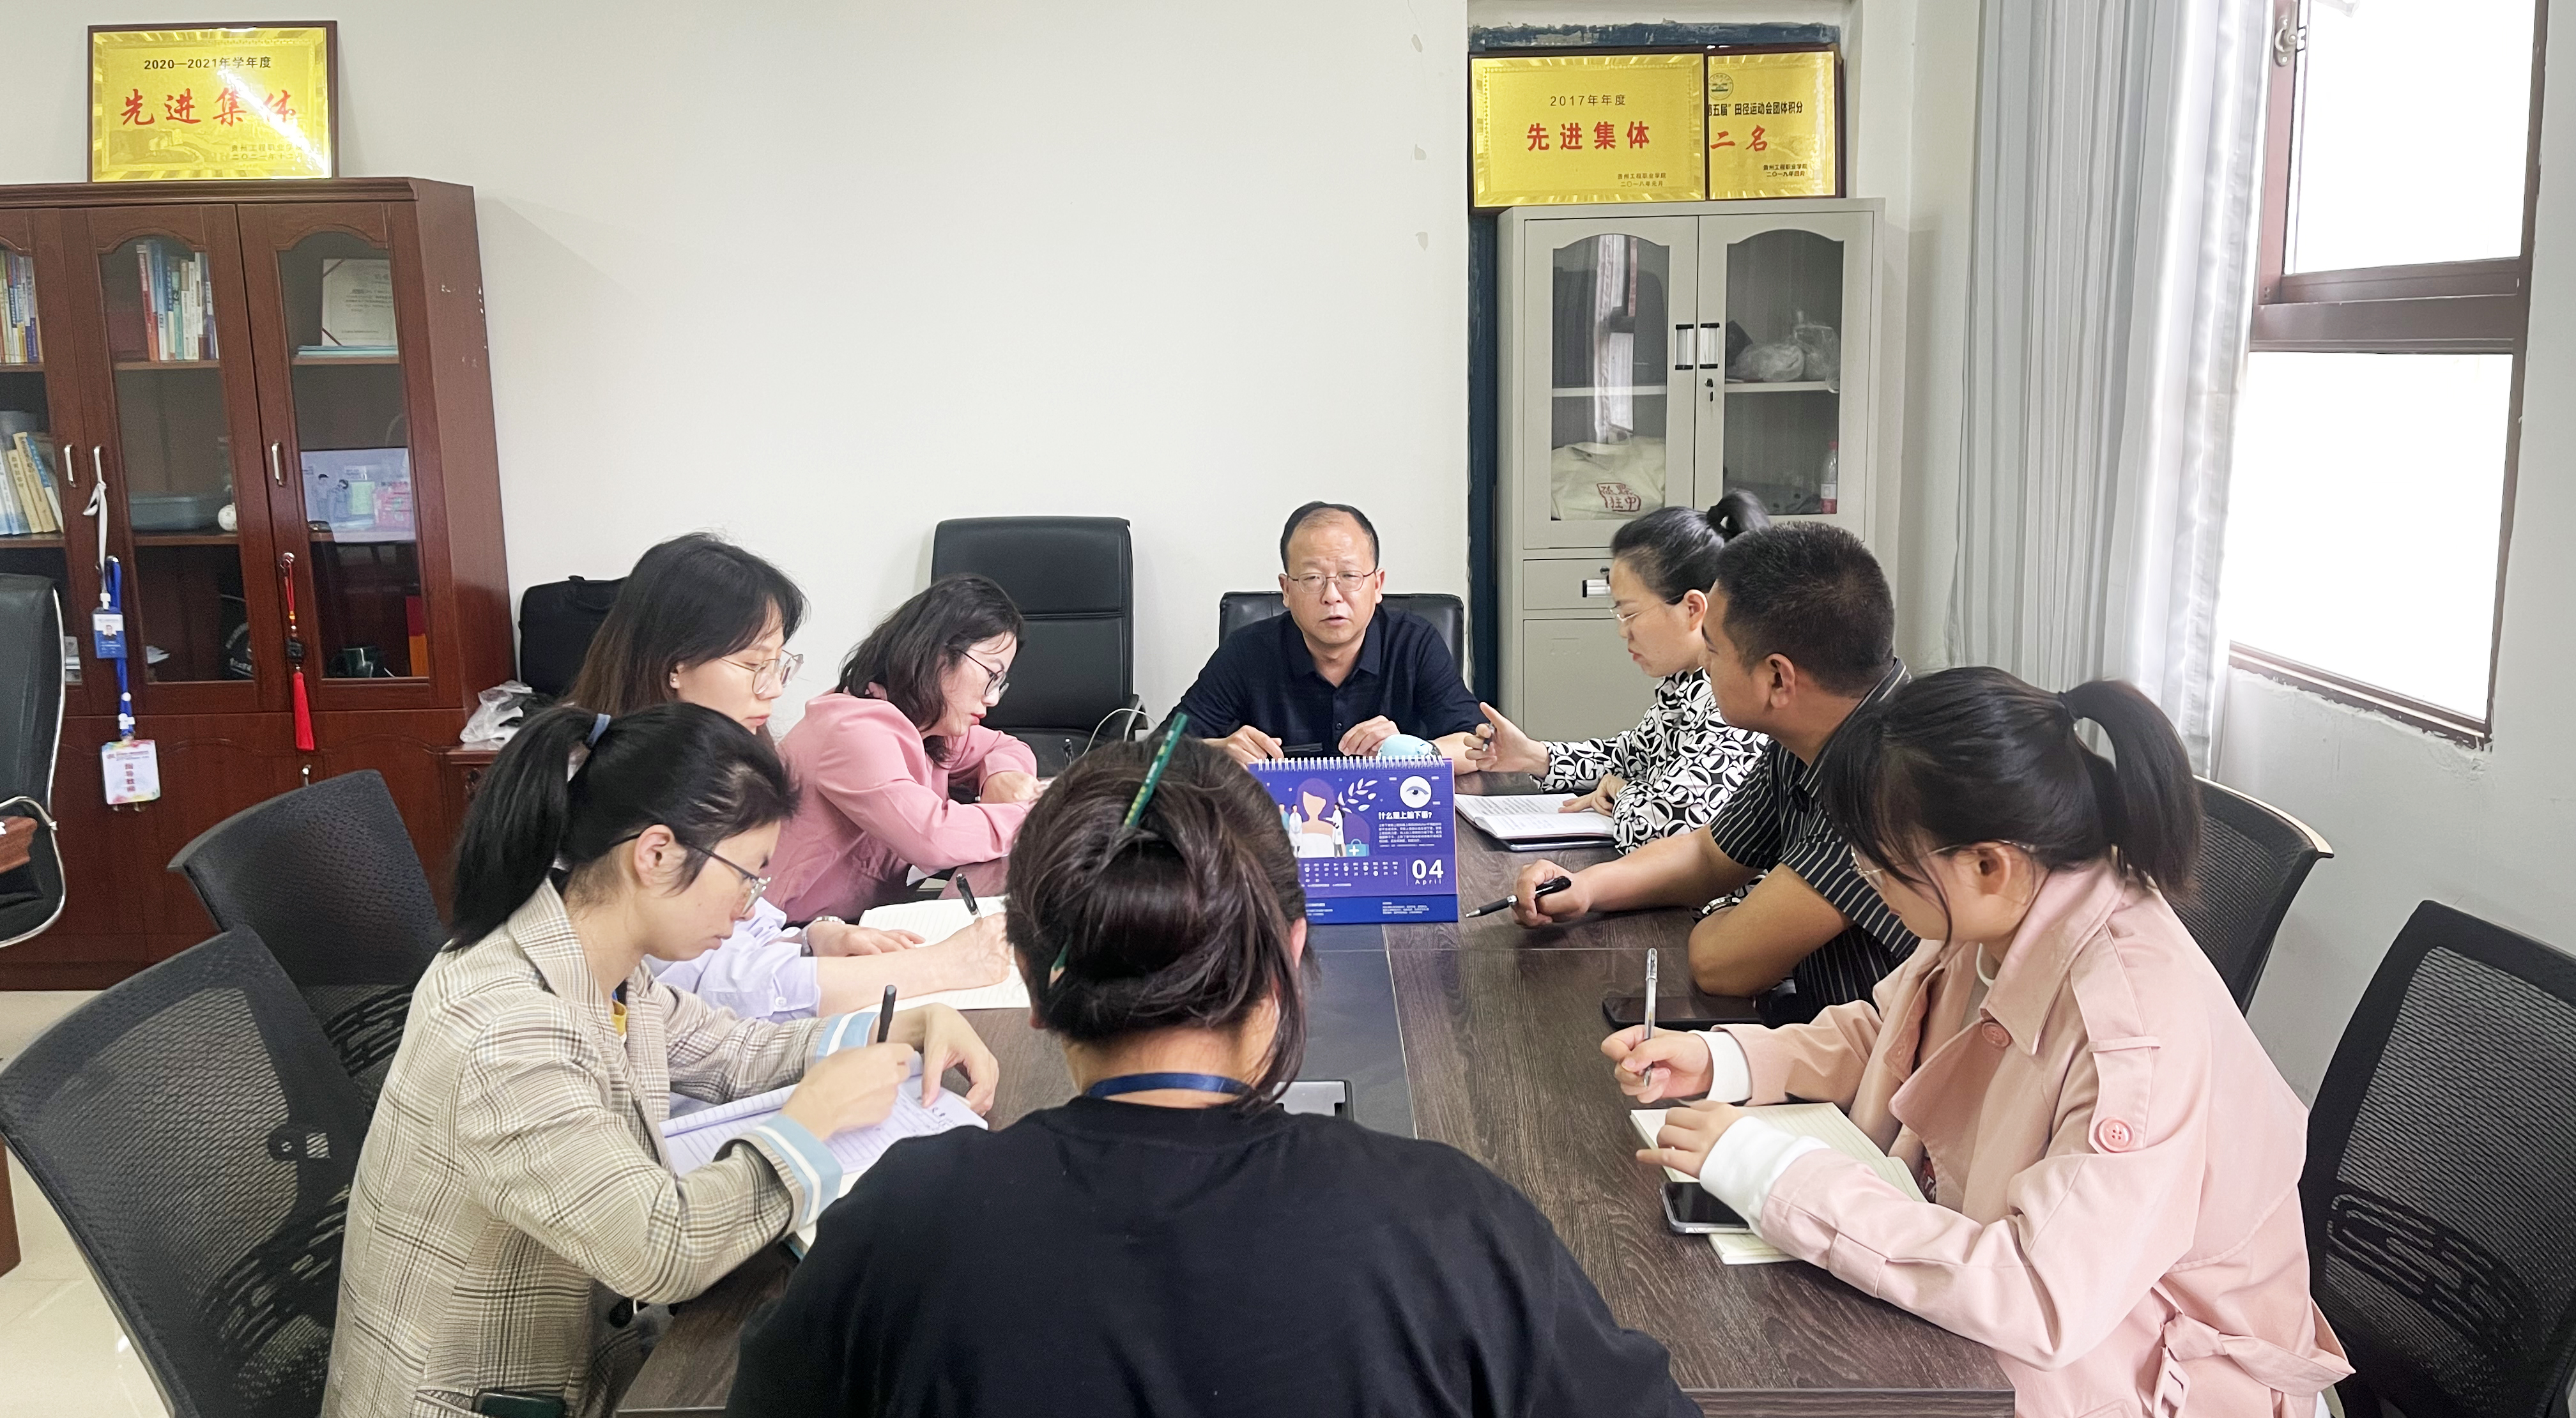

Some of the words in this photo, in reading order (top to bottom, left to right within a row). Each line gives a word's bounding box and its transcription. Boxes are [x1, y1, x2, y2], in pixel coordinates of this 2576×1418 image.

[120, 88, 297, 127] 先进集体
[1550, 94, 1626, 107] 2017年年度
[1527, 121, 1650, 151] 先进集体
[1710, 125, 1768, 152] 二名
[1412, 858, 1444, 879] 04
